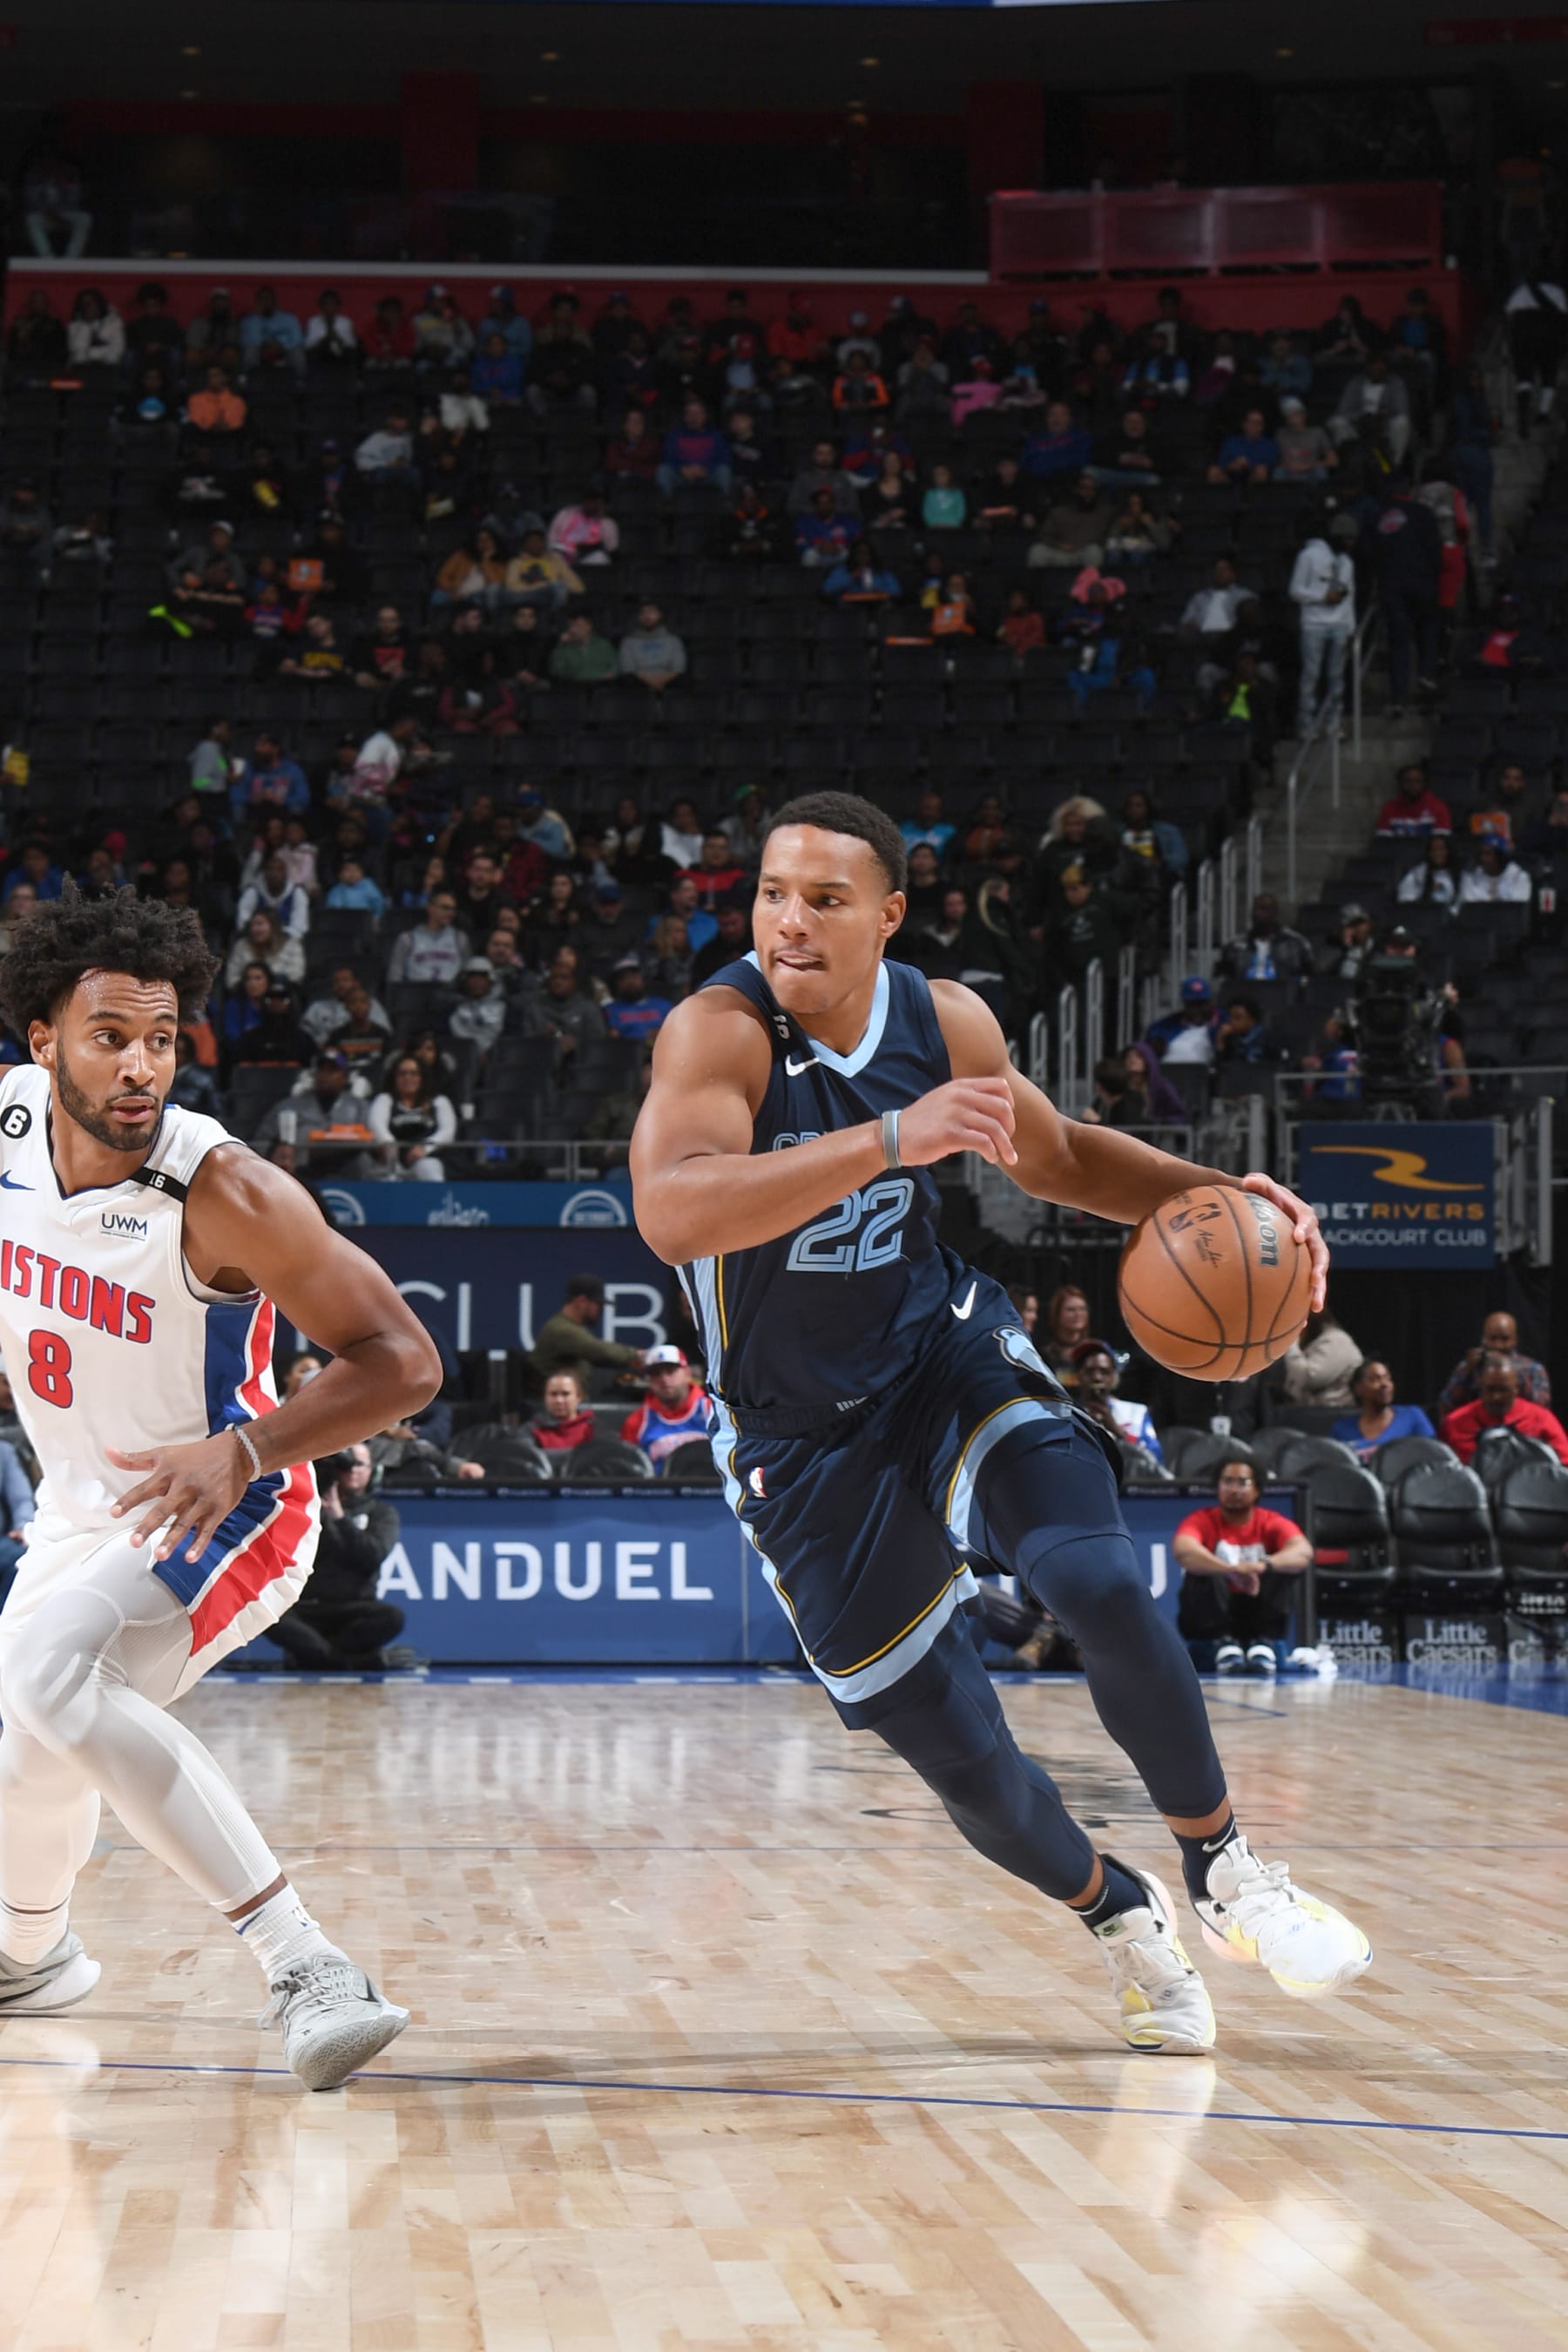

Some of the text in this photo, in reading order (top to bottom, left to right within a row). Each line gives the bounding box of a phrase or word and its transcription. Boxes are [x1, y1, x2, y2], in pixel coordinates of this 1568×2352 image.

[3, 1107, 29, 1136] 6
[148, 1172, 166, 1188] 16
[1311, 1202, 1485, 1220] BETRIVERS
[101, 1213, 148, 1235] UWM
[786, 1178, 915, 1273] 22
[1322, 1228, 1486, 1247] ACKCOURT CLUB
[0, 1239, 156, 1344] ISTONS
[28, 1328, 73, 1409] 8
[375, 1541, 714, 1601] ANDUEL
[1320, 1619, 1383, 1645] Little
[1424, 1619, 1487, 1644] Little
[1334, 1642, 1393, 1663] esars
[1406, 1639, 1497, 1663] Caesars
